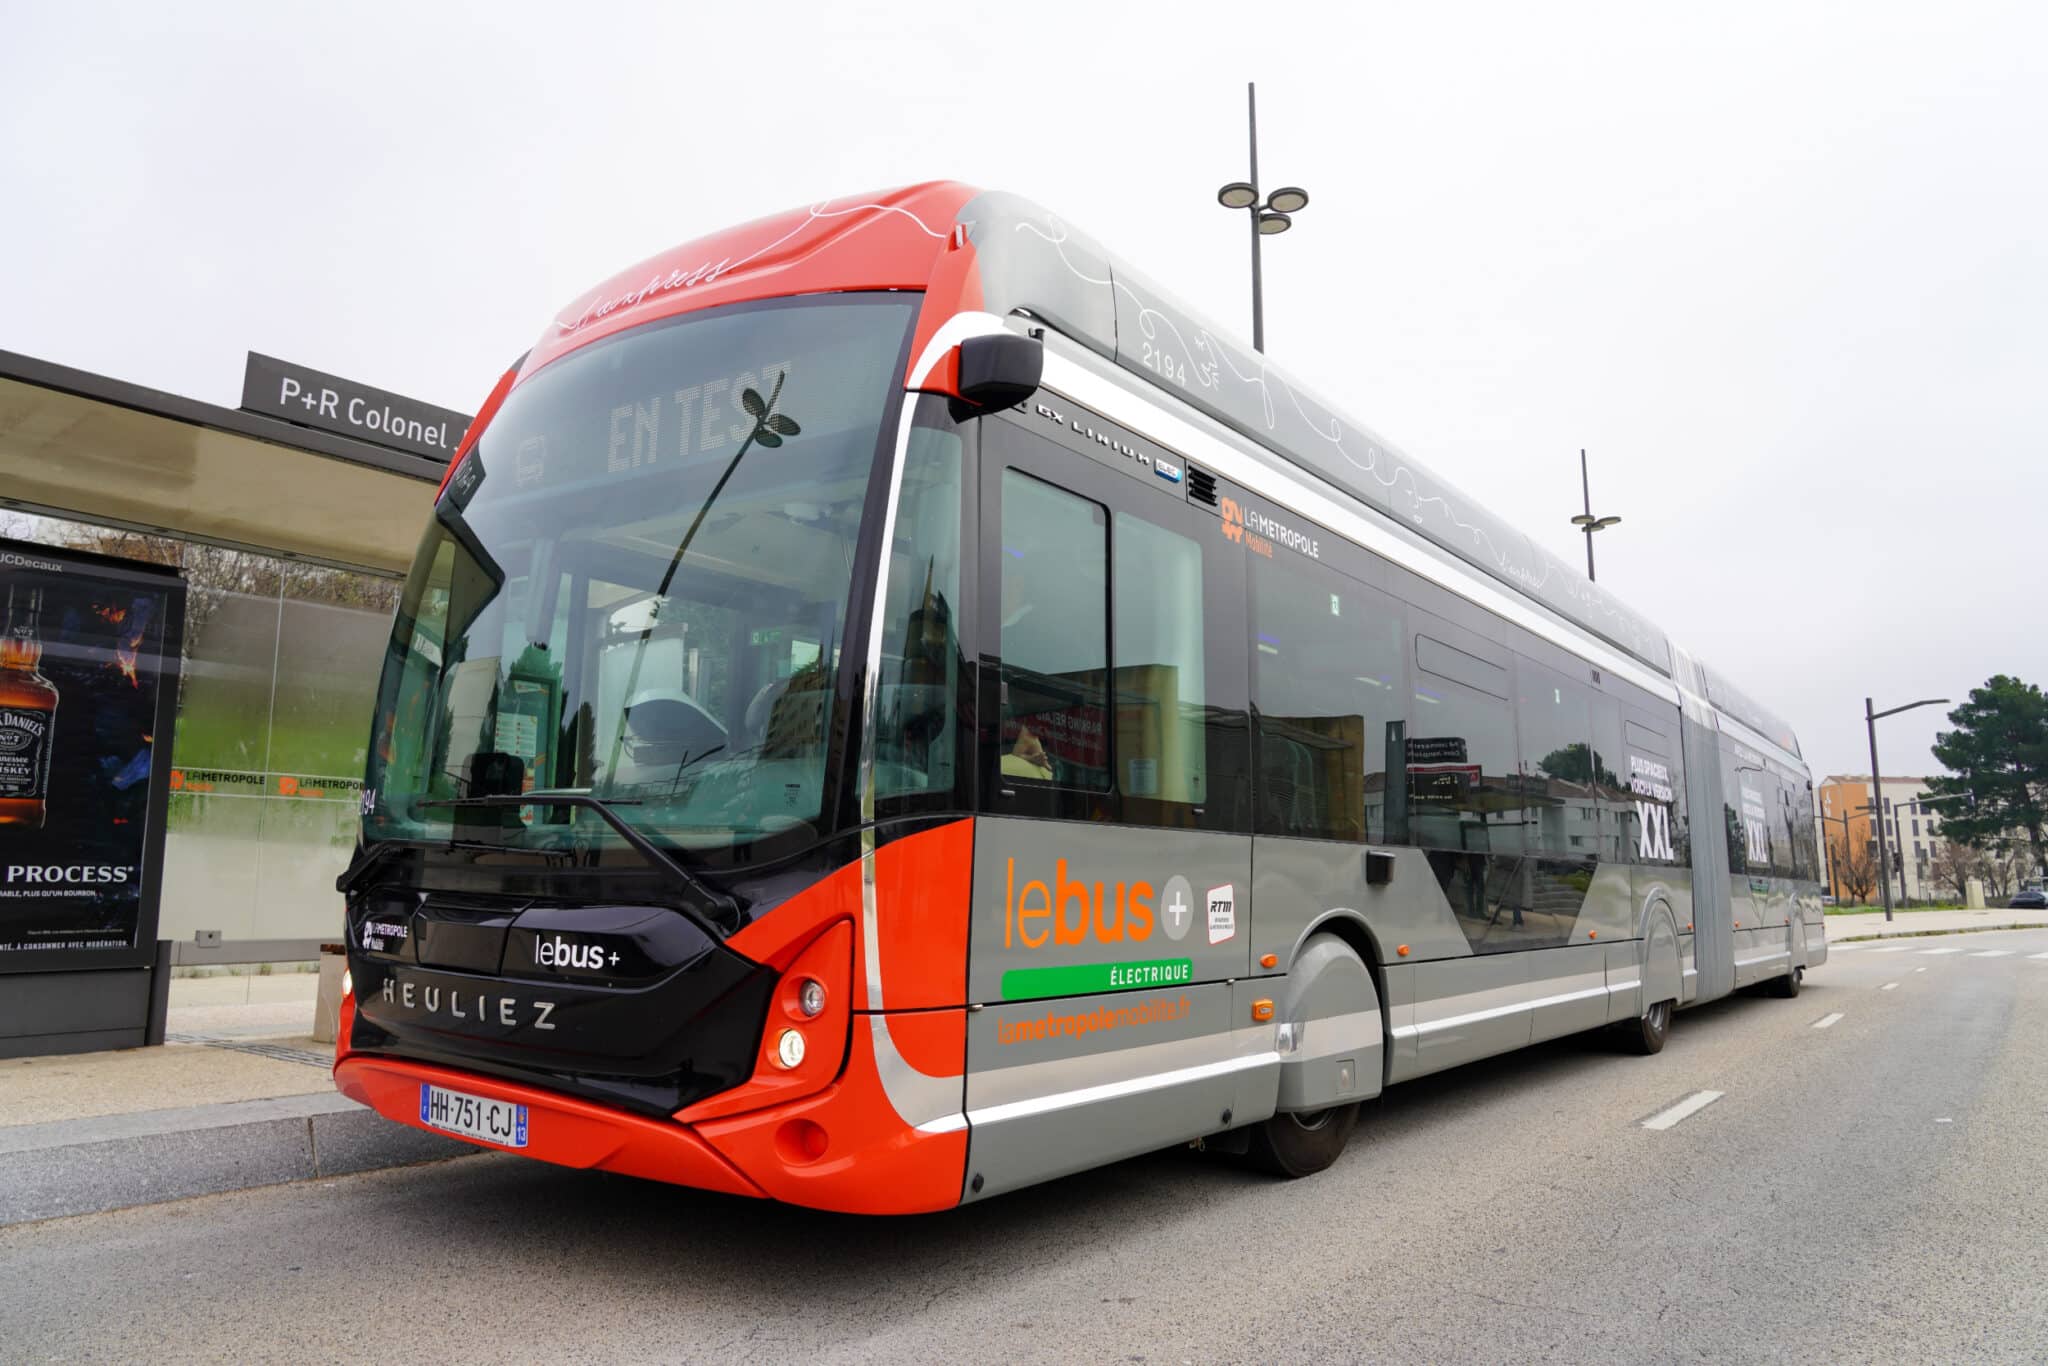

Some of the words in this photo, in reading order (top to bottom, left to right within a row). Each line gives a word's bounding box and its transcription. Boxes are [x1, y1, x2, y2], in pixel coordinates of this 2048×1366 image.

[1143, 341, 1185, 388] 2194
[280, 377, 339, 419] P+R
[348, 398, 447, 449] Colonel
[608, 396, 661, 473] EN
[674, 361, 792, 456] TEST
[1037, 403, 1064, 424] GX
[1072, 421, 1150, 466] LINIUM
[1244, 508, 1319, 559] LAMETROPOLE
[0, 553, 63, 572] JCDecaux
[186, 770, 265, 785] LAMETROPOLE
[299, 777, 365, 792] LAMETROPO
[1635, 800, 1674, 861] XXL
[1005, 857, 1154, 949] lebus
[1210, 901, 1232, 912] RTM
[535, 934, 604, 970] lebus
[1110, 964, 1189, 986] ÉLECTRIQUE
[382, 979, 557, 1030] HEULIEZ
[430, 1090, 512, 1137] HH-751-CJ
